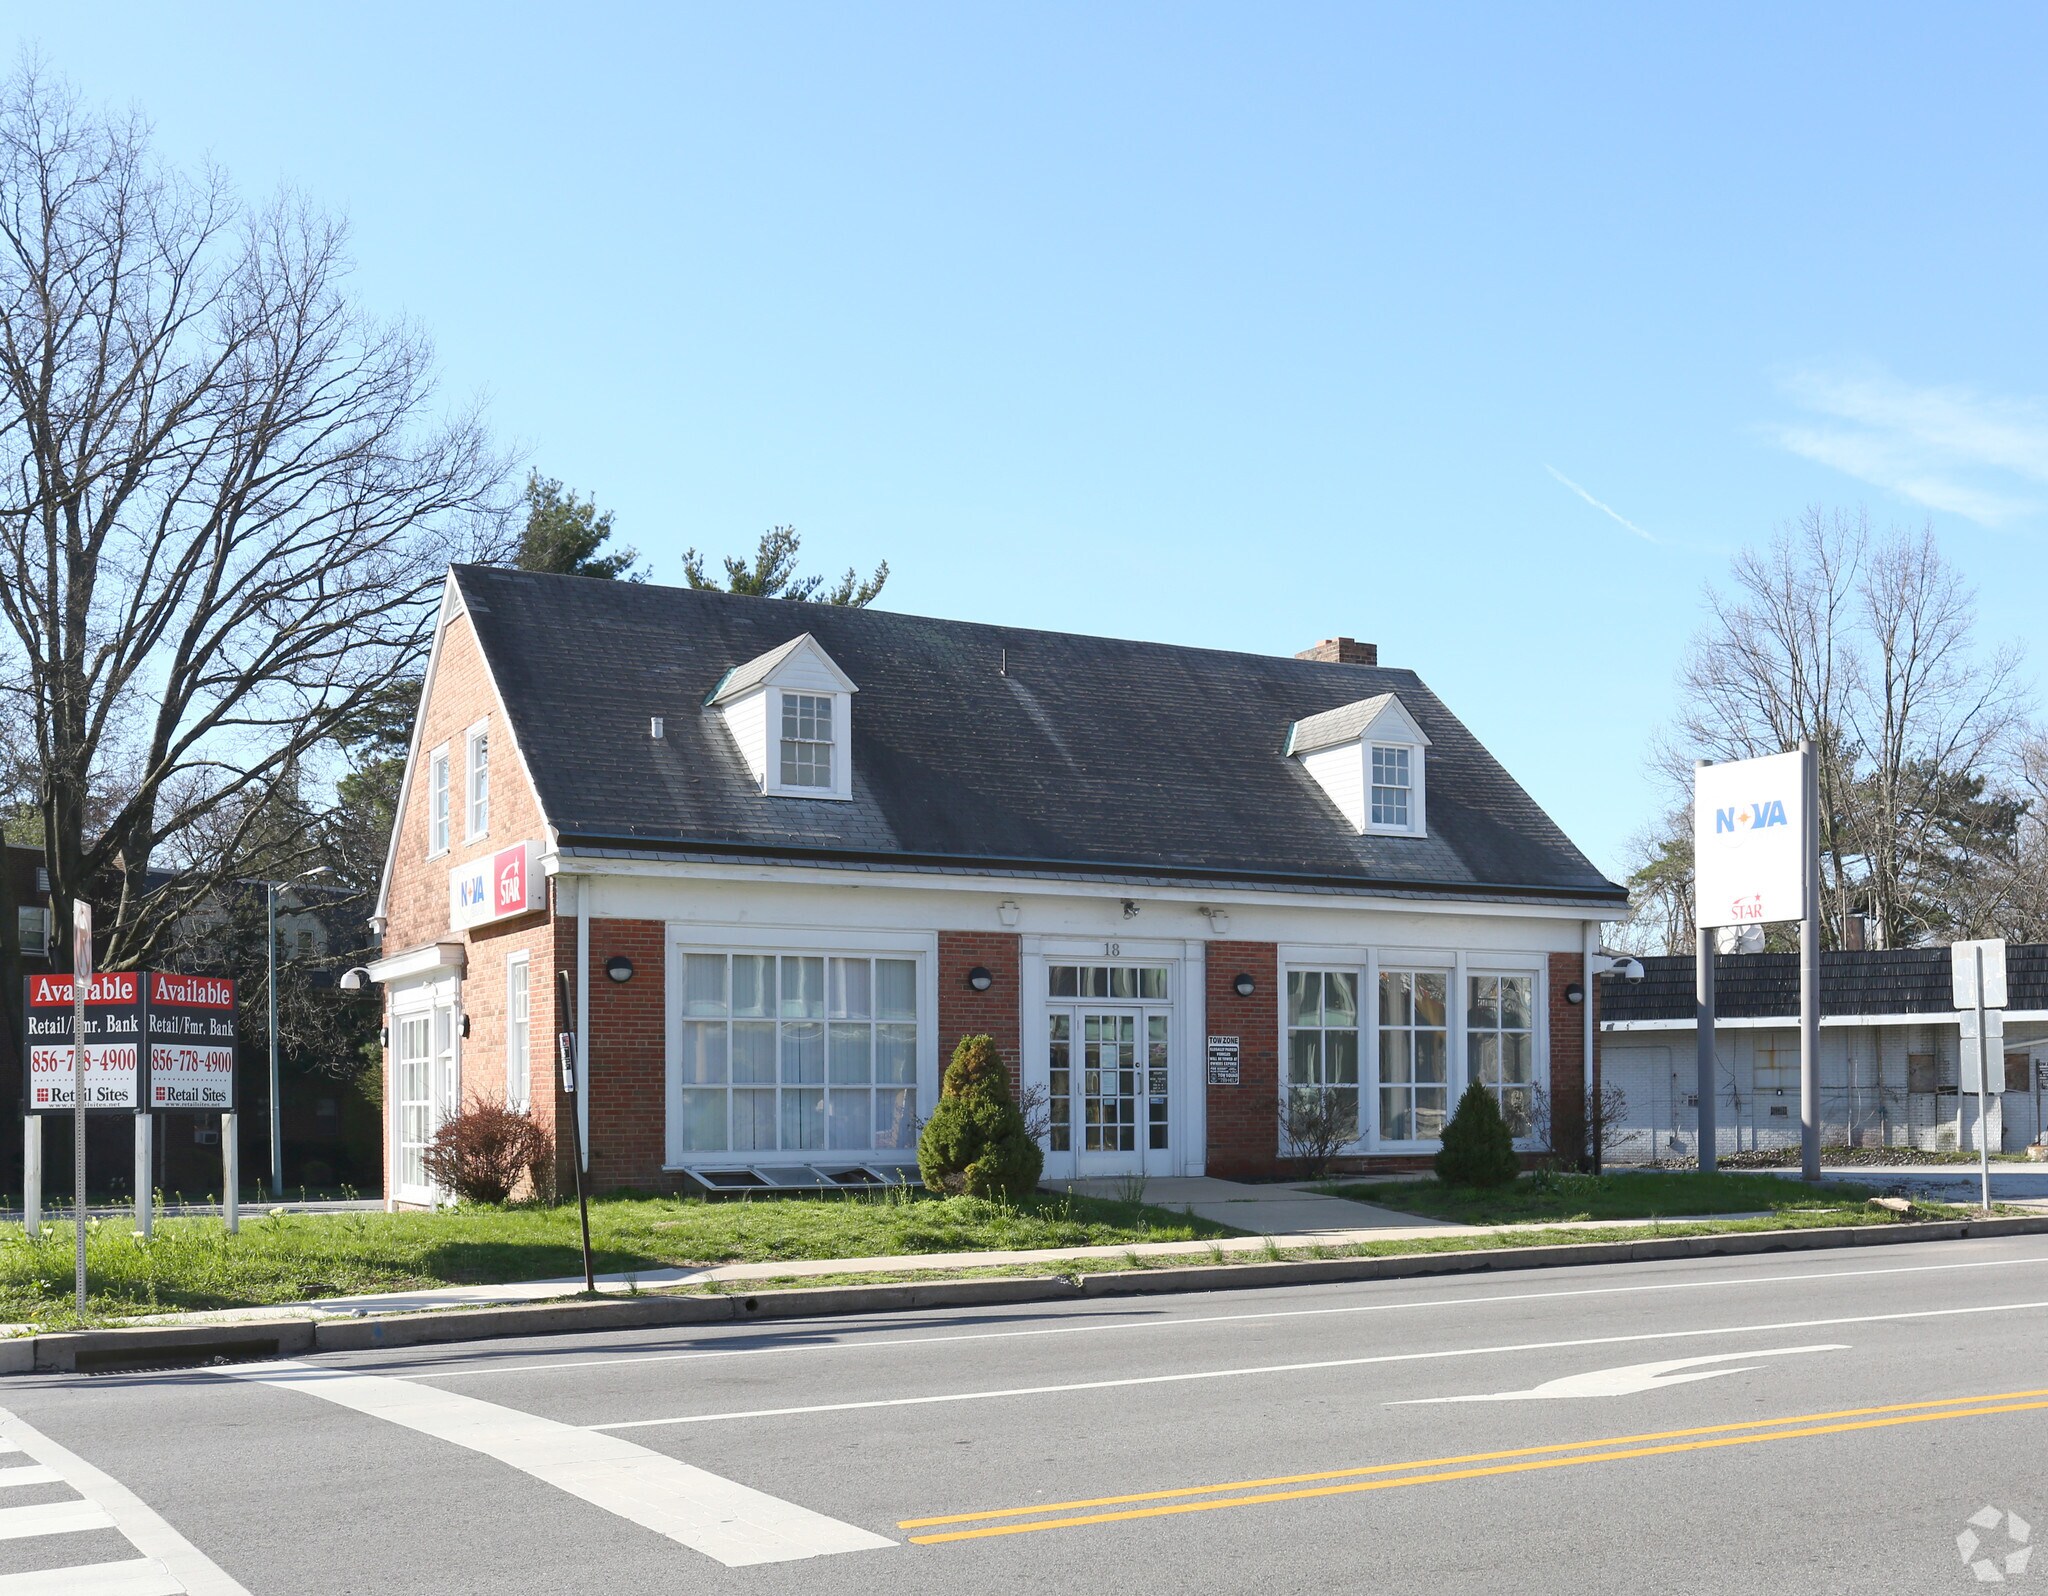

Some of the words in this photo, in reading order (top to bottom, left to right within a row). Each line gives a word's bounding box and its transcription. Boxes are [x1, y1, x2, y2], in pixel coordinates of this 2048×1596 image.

[500, 876, 521, 906] STAR
[1731, 903, 1763, 921] STAR
[1104, 942, 1120, 957] 18
[35, 976, 133, 1002] Avalable
[155, 976, 230, 1005] Available
[106, 1014, 139, 1033] Bank
[149, 1014, 206, 1035] Retail/Fmr.
[210, 1018, 234, 1037] Bank
[32, 1048, 136, 1073] 856-78-4900
[152, 1049, 232, 1073] 856-778-4900
[51, 1087, 92, 1102] Retil
[97, 1086, 129, 1102] Sites
[167, 1086, 199, 1102] Retail
[202, 1087, 227, 1102] Sites
